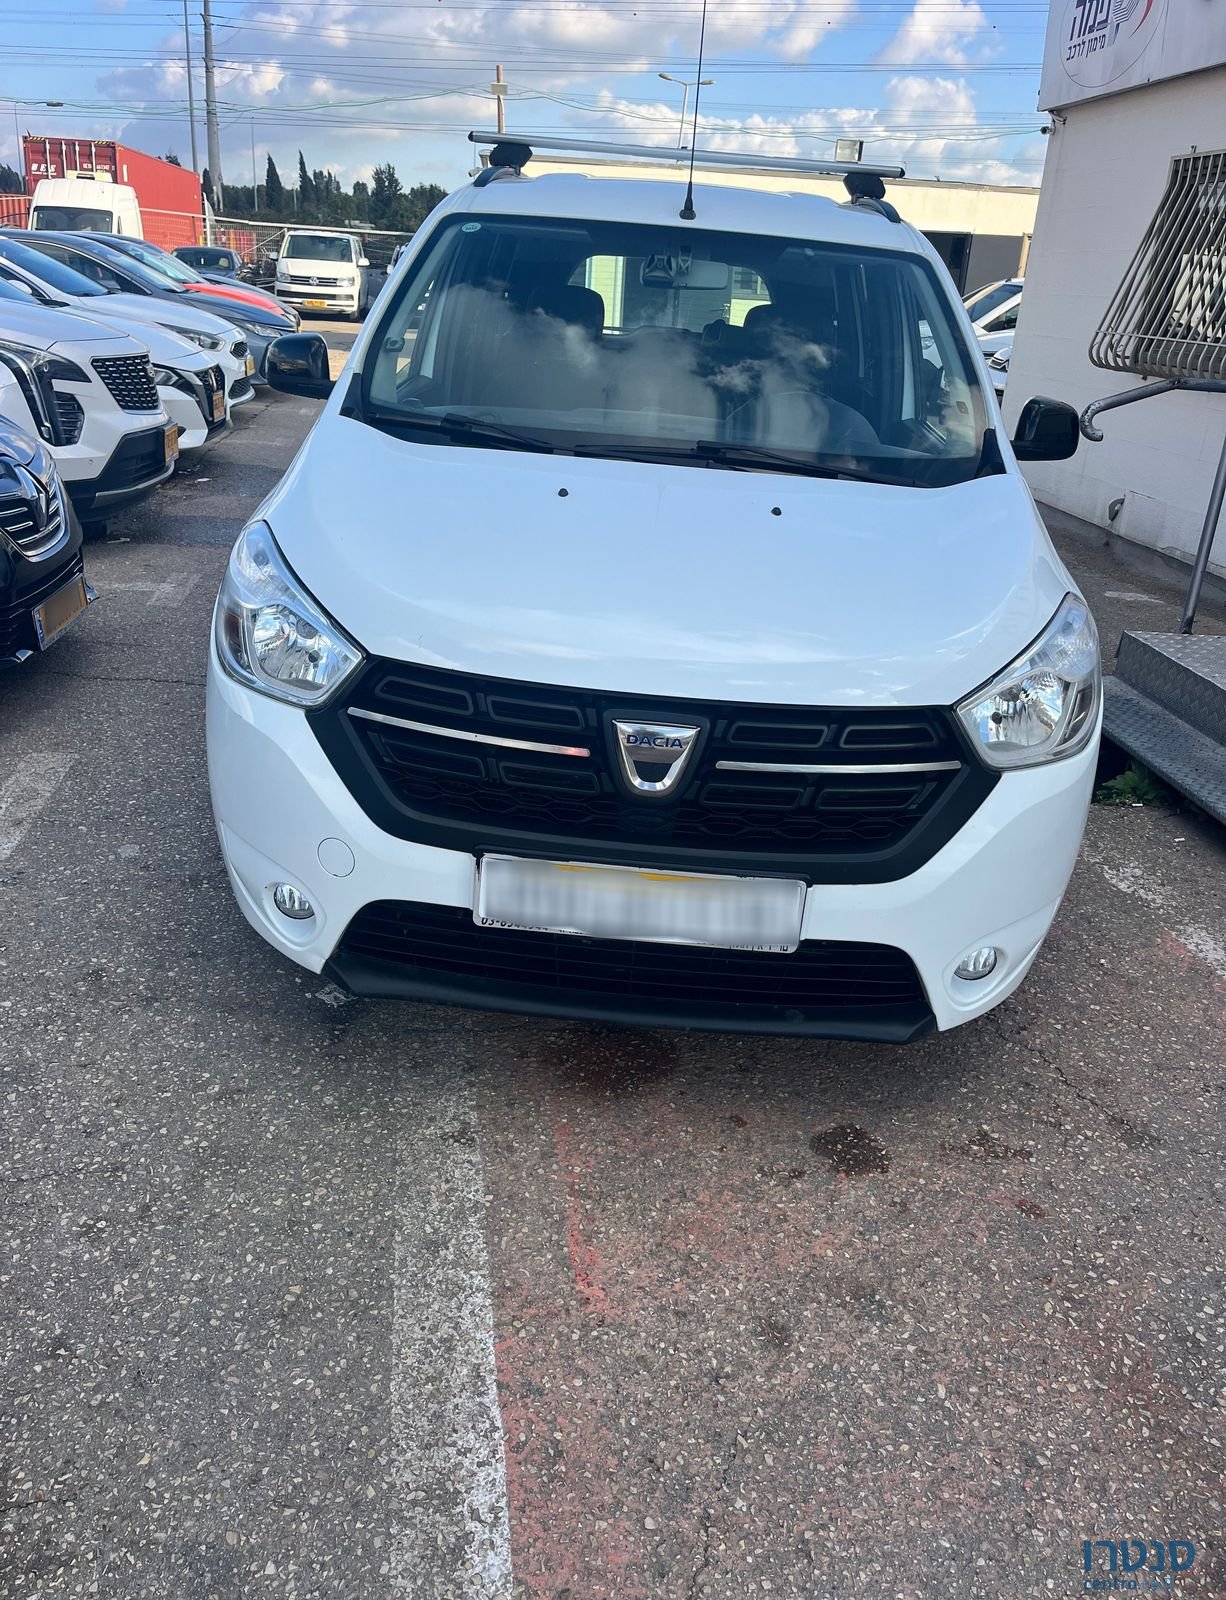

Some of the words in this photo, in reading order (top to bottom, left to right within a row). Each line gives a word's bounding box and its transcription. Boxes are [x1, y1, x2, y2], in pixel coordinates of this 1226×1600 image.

[1066, 38, 1087, 61] לרכב
[1086, 33, 1106, 59] מימון
[626, 734, 684, 749] DACIA
